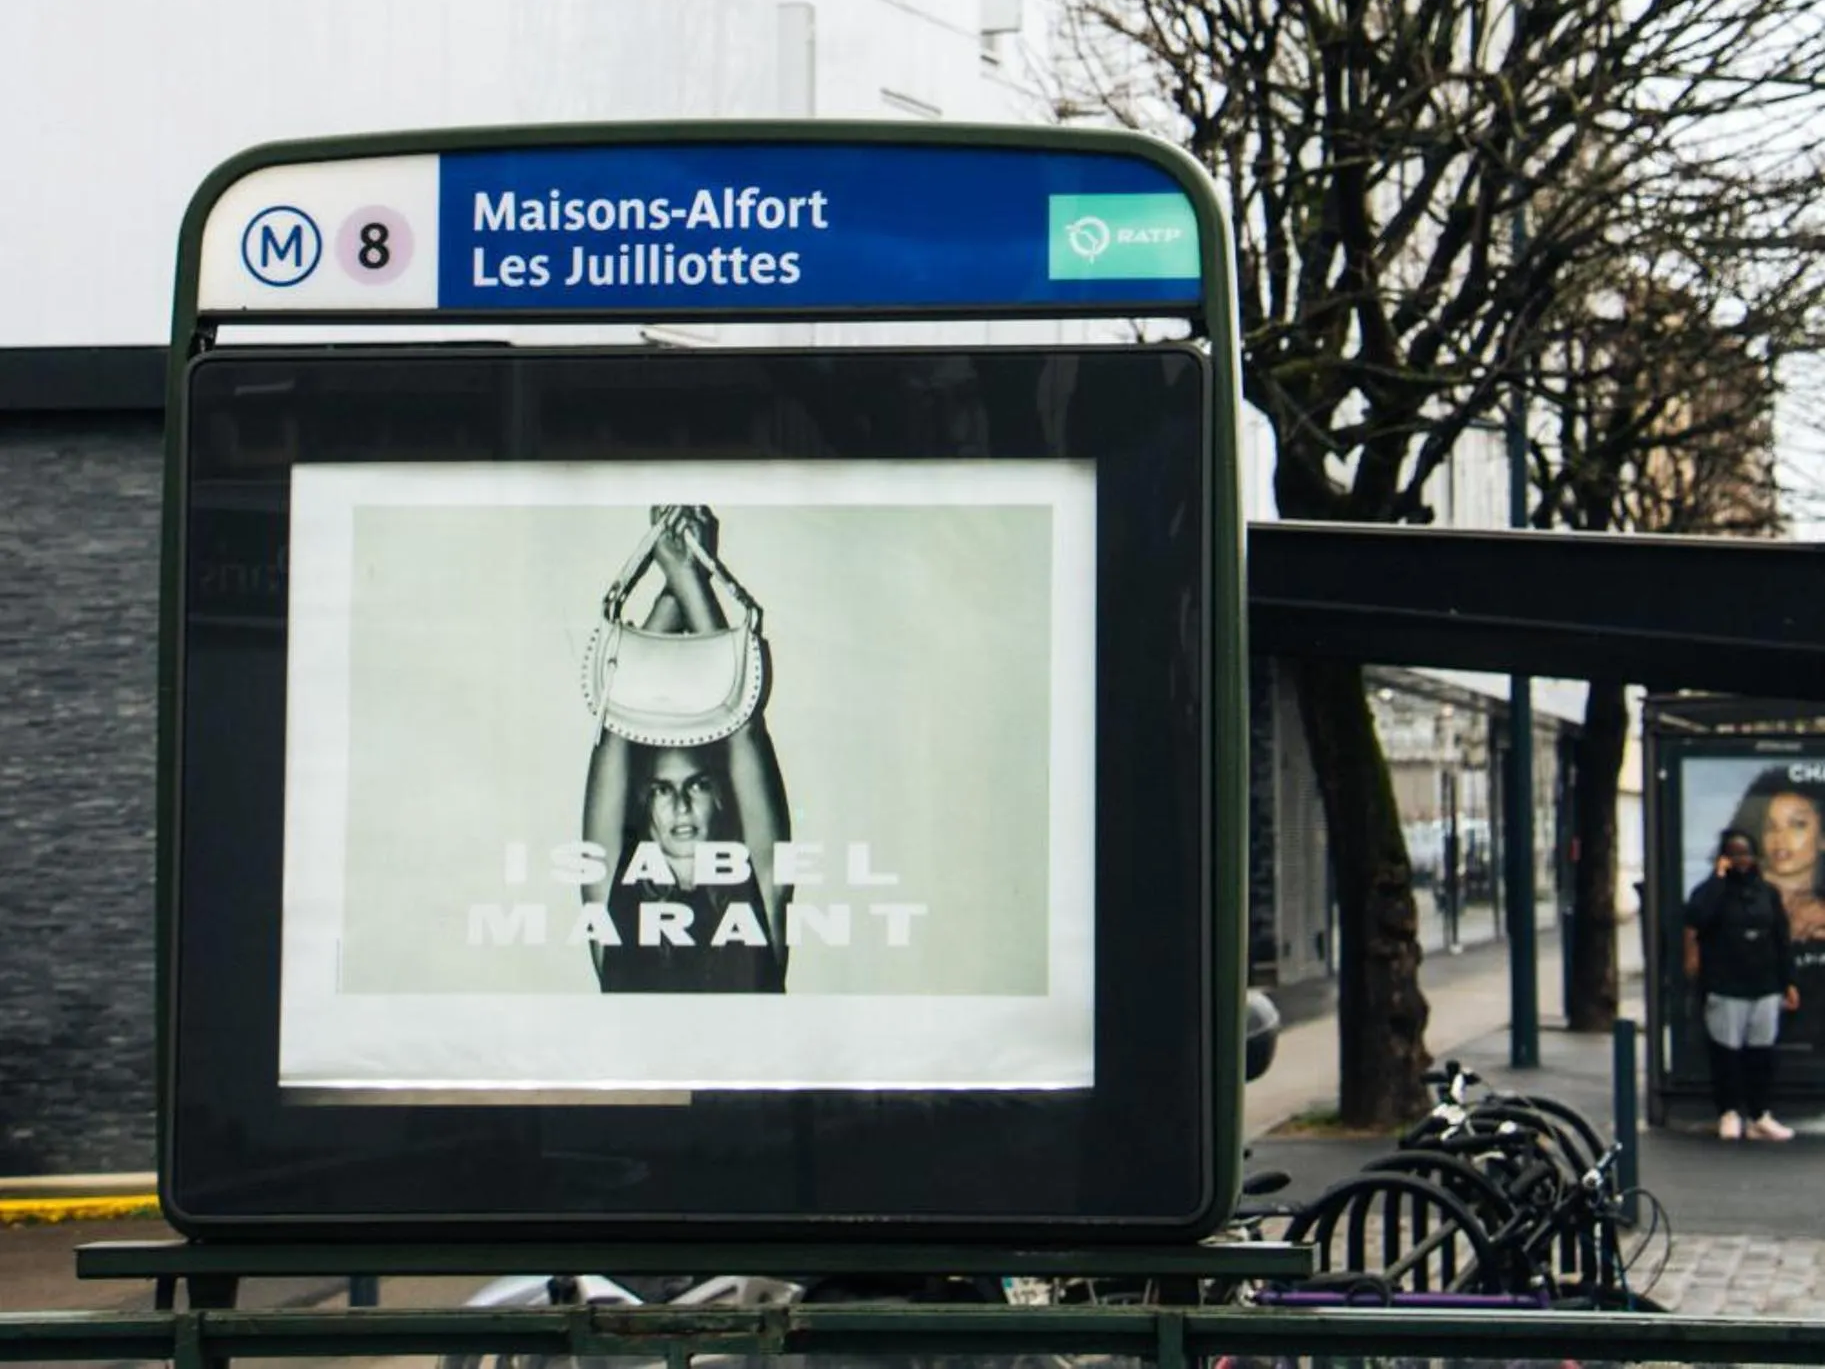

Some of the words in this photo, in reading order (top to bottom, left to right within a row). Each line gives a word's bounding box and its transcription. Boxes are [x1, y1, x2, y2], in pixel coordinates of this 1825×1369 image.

[473, 186, 829, 232] Maisons-Alfort
[260, 224, 304, 268] M
[357, 222, 391, 270] 8
[1116, 227, 1183, 245] RATP
[472, 246, 551, 288] Les
[564, 242, 802, 287] Juilliottes
[502, 839, 900, 887] ISABEL
[466, 901, 929, 948] MARANT
